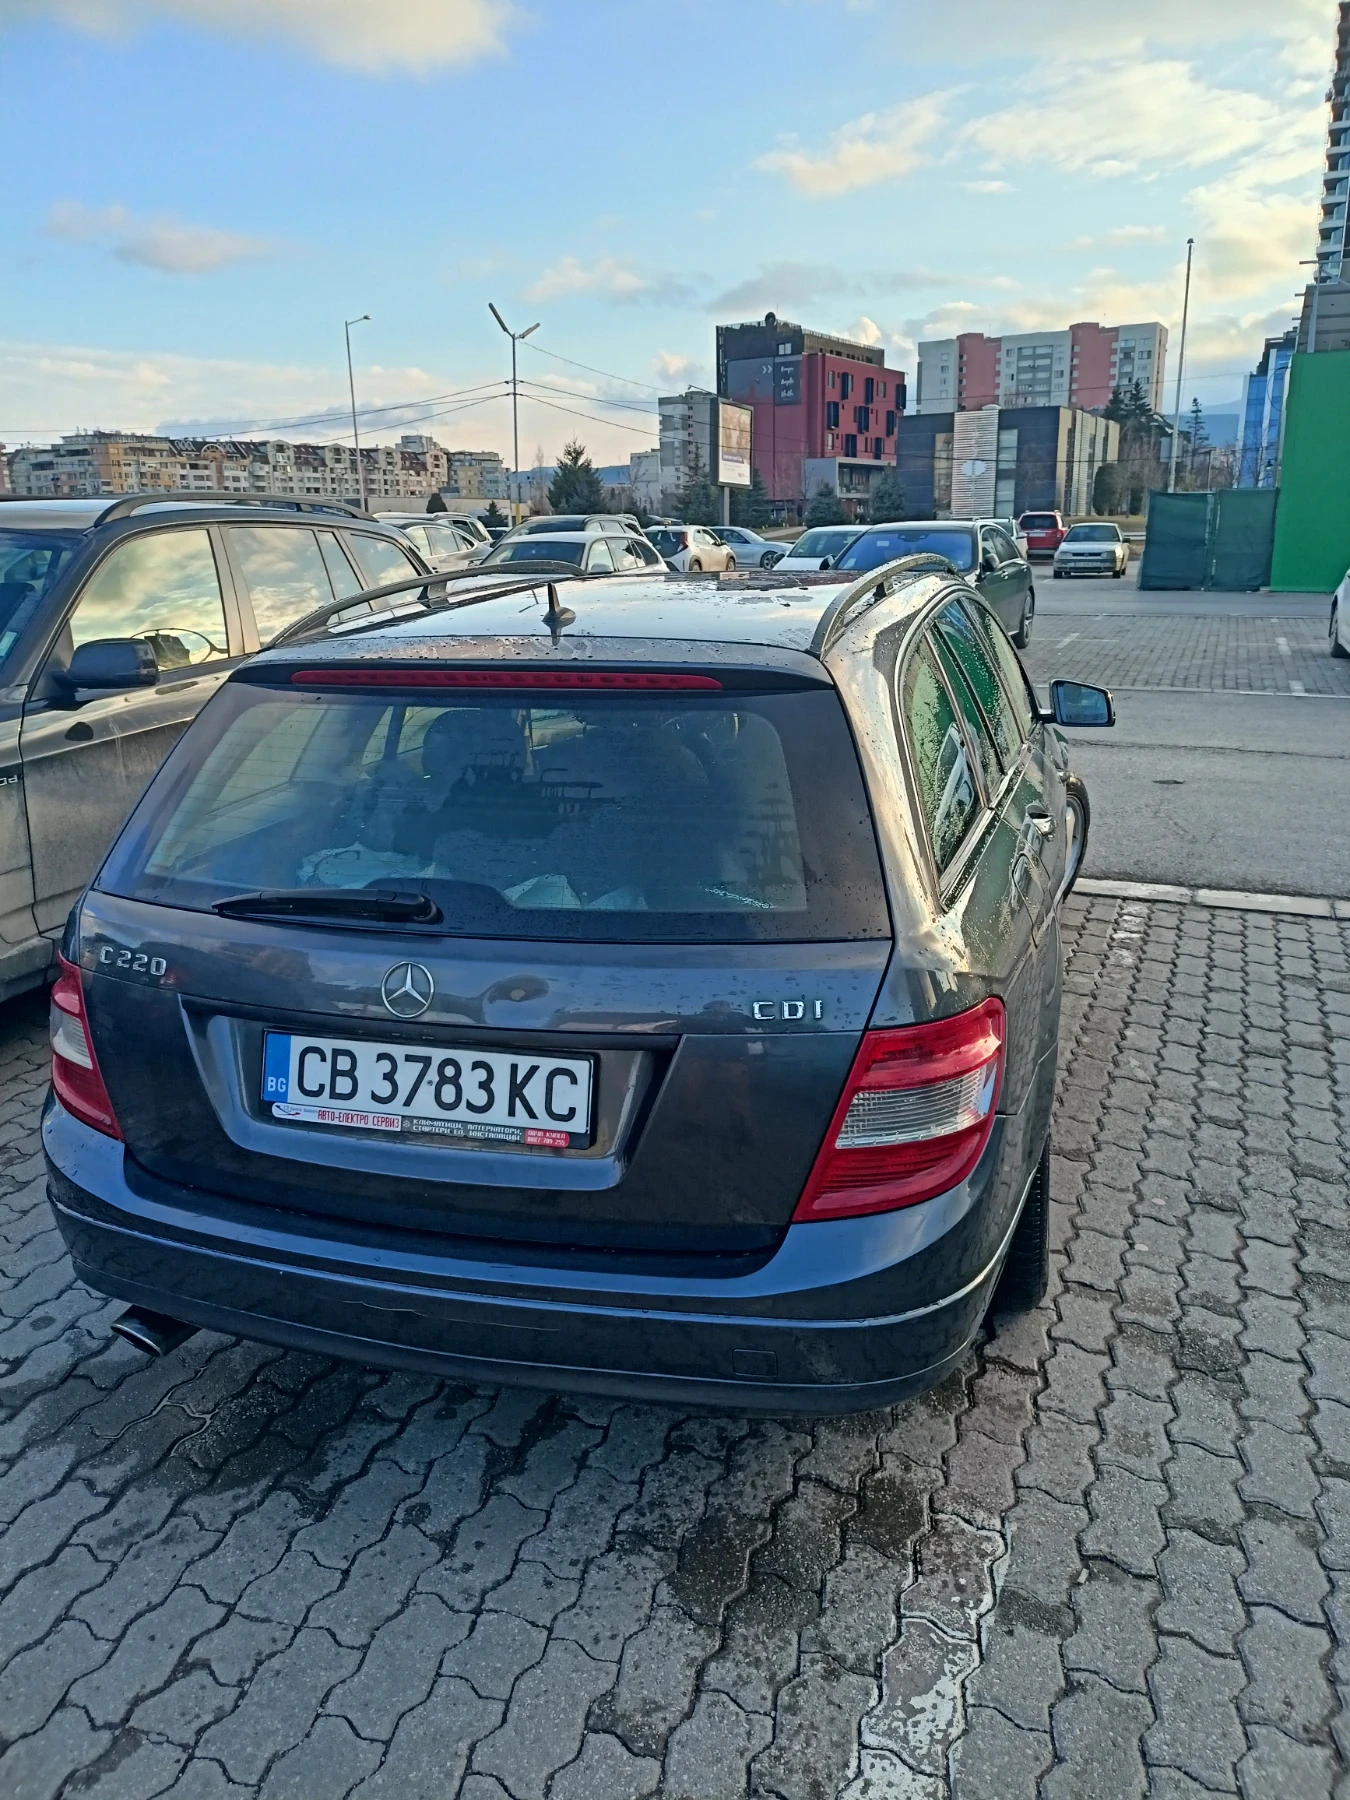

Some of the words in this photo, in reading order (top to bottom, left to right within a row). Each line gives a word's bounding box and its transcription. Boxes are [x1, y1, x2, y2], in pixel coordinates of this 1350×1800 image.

[752, 1000, 823, 1020] CDI
[267, 1076, 287, 1093] BG
[297, 1046, 359, 1101] CB
[370, 1052, 495, 1114] 3783
[507, 1063, 579, 1123] KC
[317, 1109, 369, 1125] АВТО-ЕЛЕКТРО
[372, 1115, 399, 1128] СЕРВИЗ
[469, 1130, 520, 1141] ИНСТАЛАЦИИ
